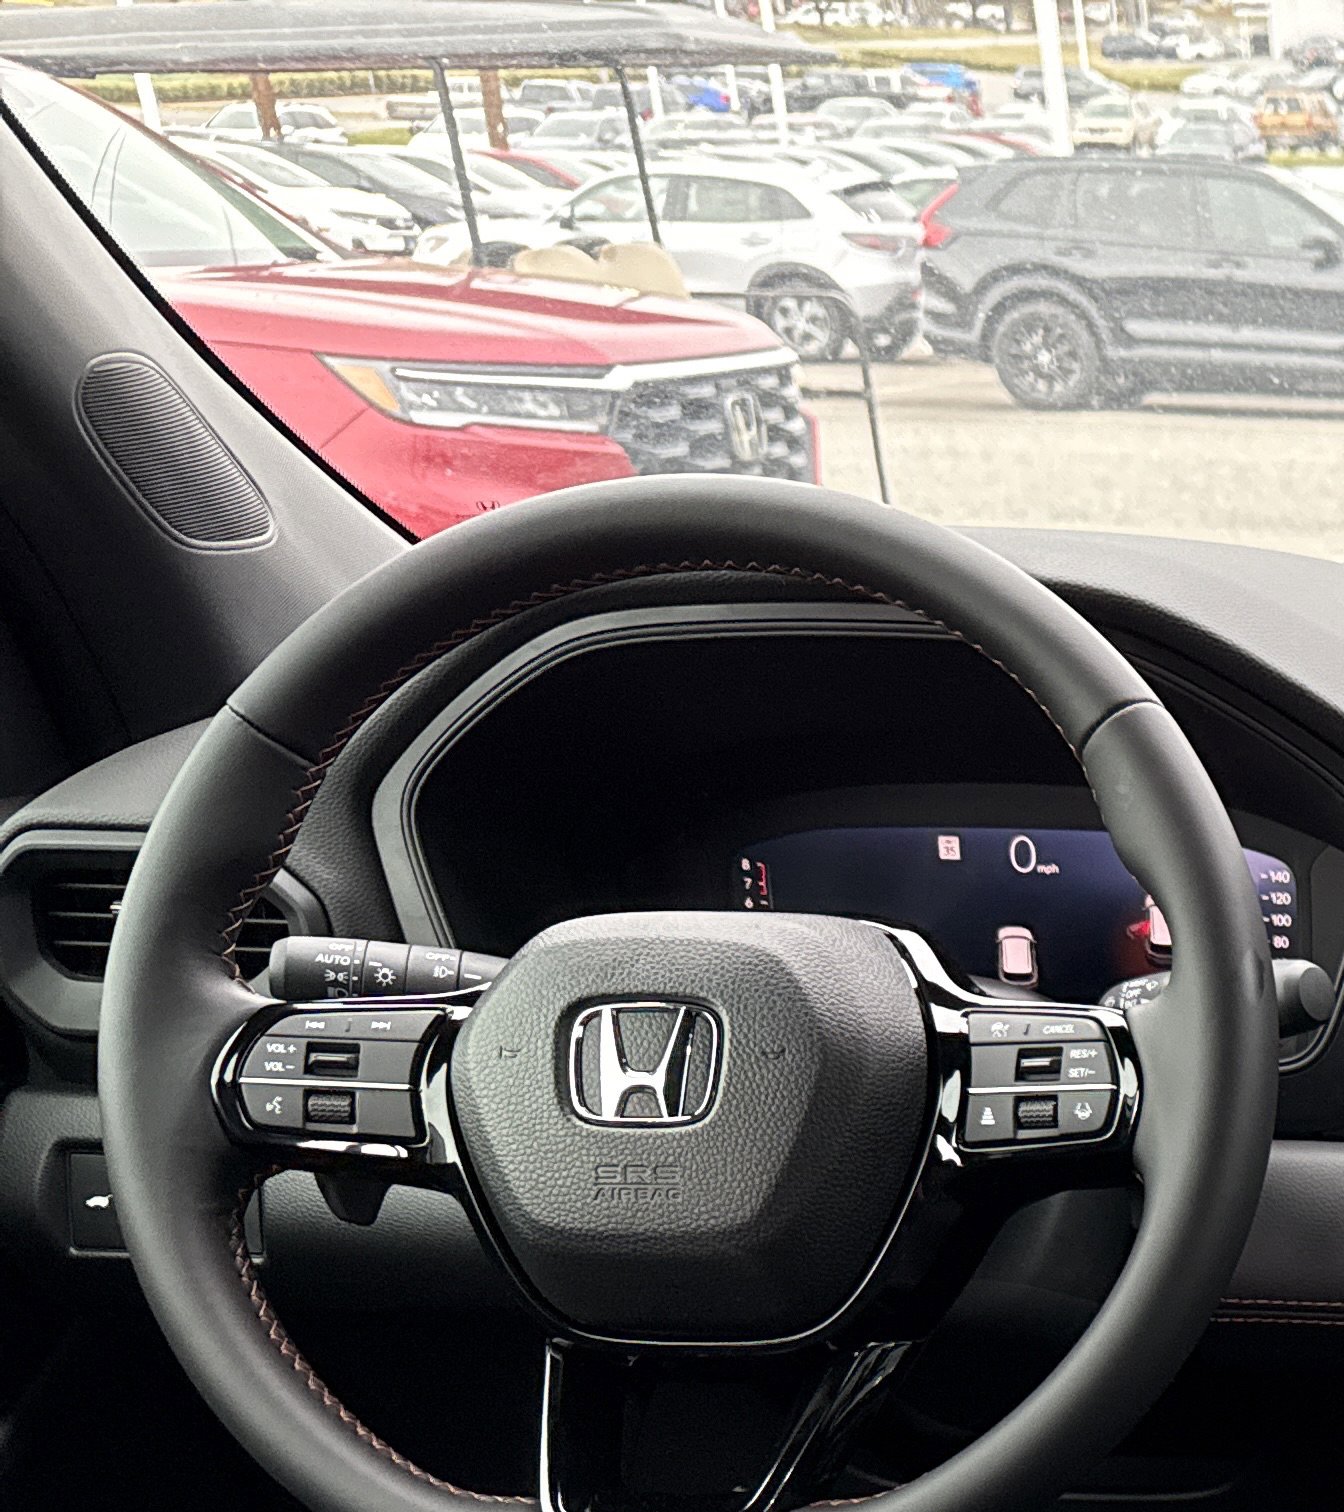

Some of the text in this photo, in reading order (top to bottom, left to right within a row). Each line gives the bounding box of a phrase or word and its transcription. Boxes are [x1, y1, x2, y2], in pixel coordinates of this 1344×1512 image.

[943, 846, 957, 856] 35
[1010, 835, 1060, 875] 0 mph
[741, 858, 751, 871] 8
[1269, 870, 1290, 883] 140
[743, 877, 753, 890] 7
[1270, 892, 1292, 905] 120
[1271, 913, 1292, 927] 100
[1273, 935, 1290, 949] 80
[315, 952, 351, 966] AUTO
[1042, 1024, 1075, 1034] CANCEL
[1070, 1049, 1098, 1059] RES/+
[595, 1164, 680, 1183] SRS
[593, 1187, 682, 1201] AIRBAG
